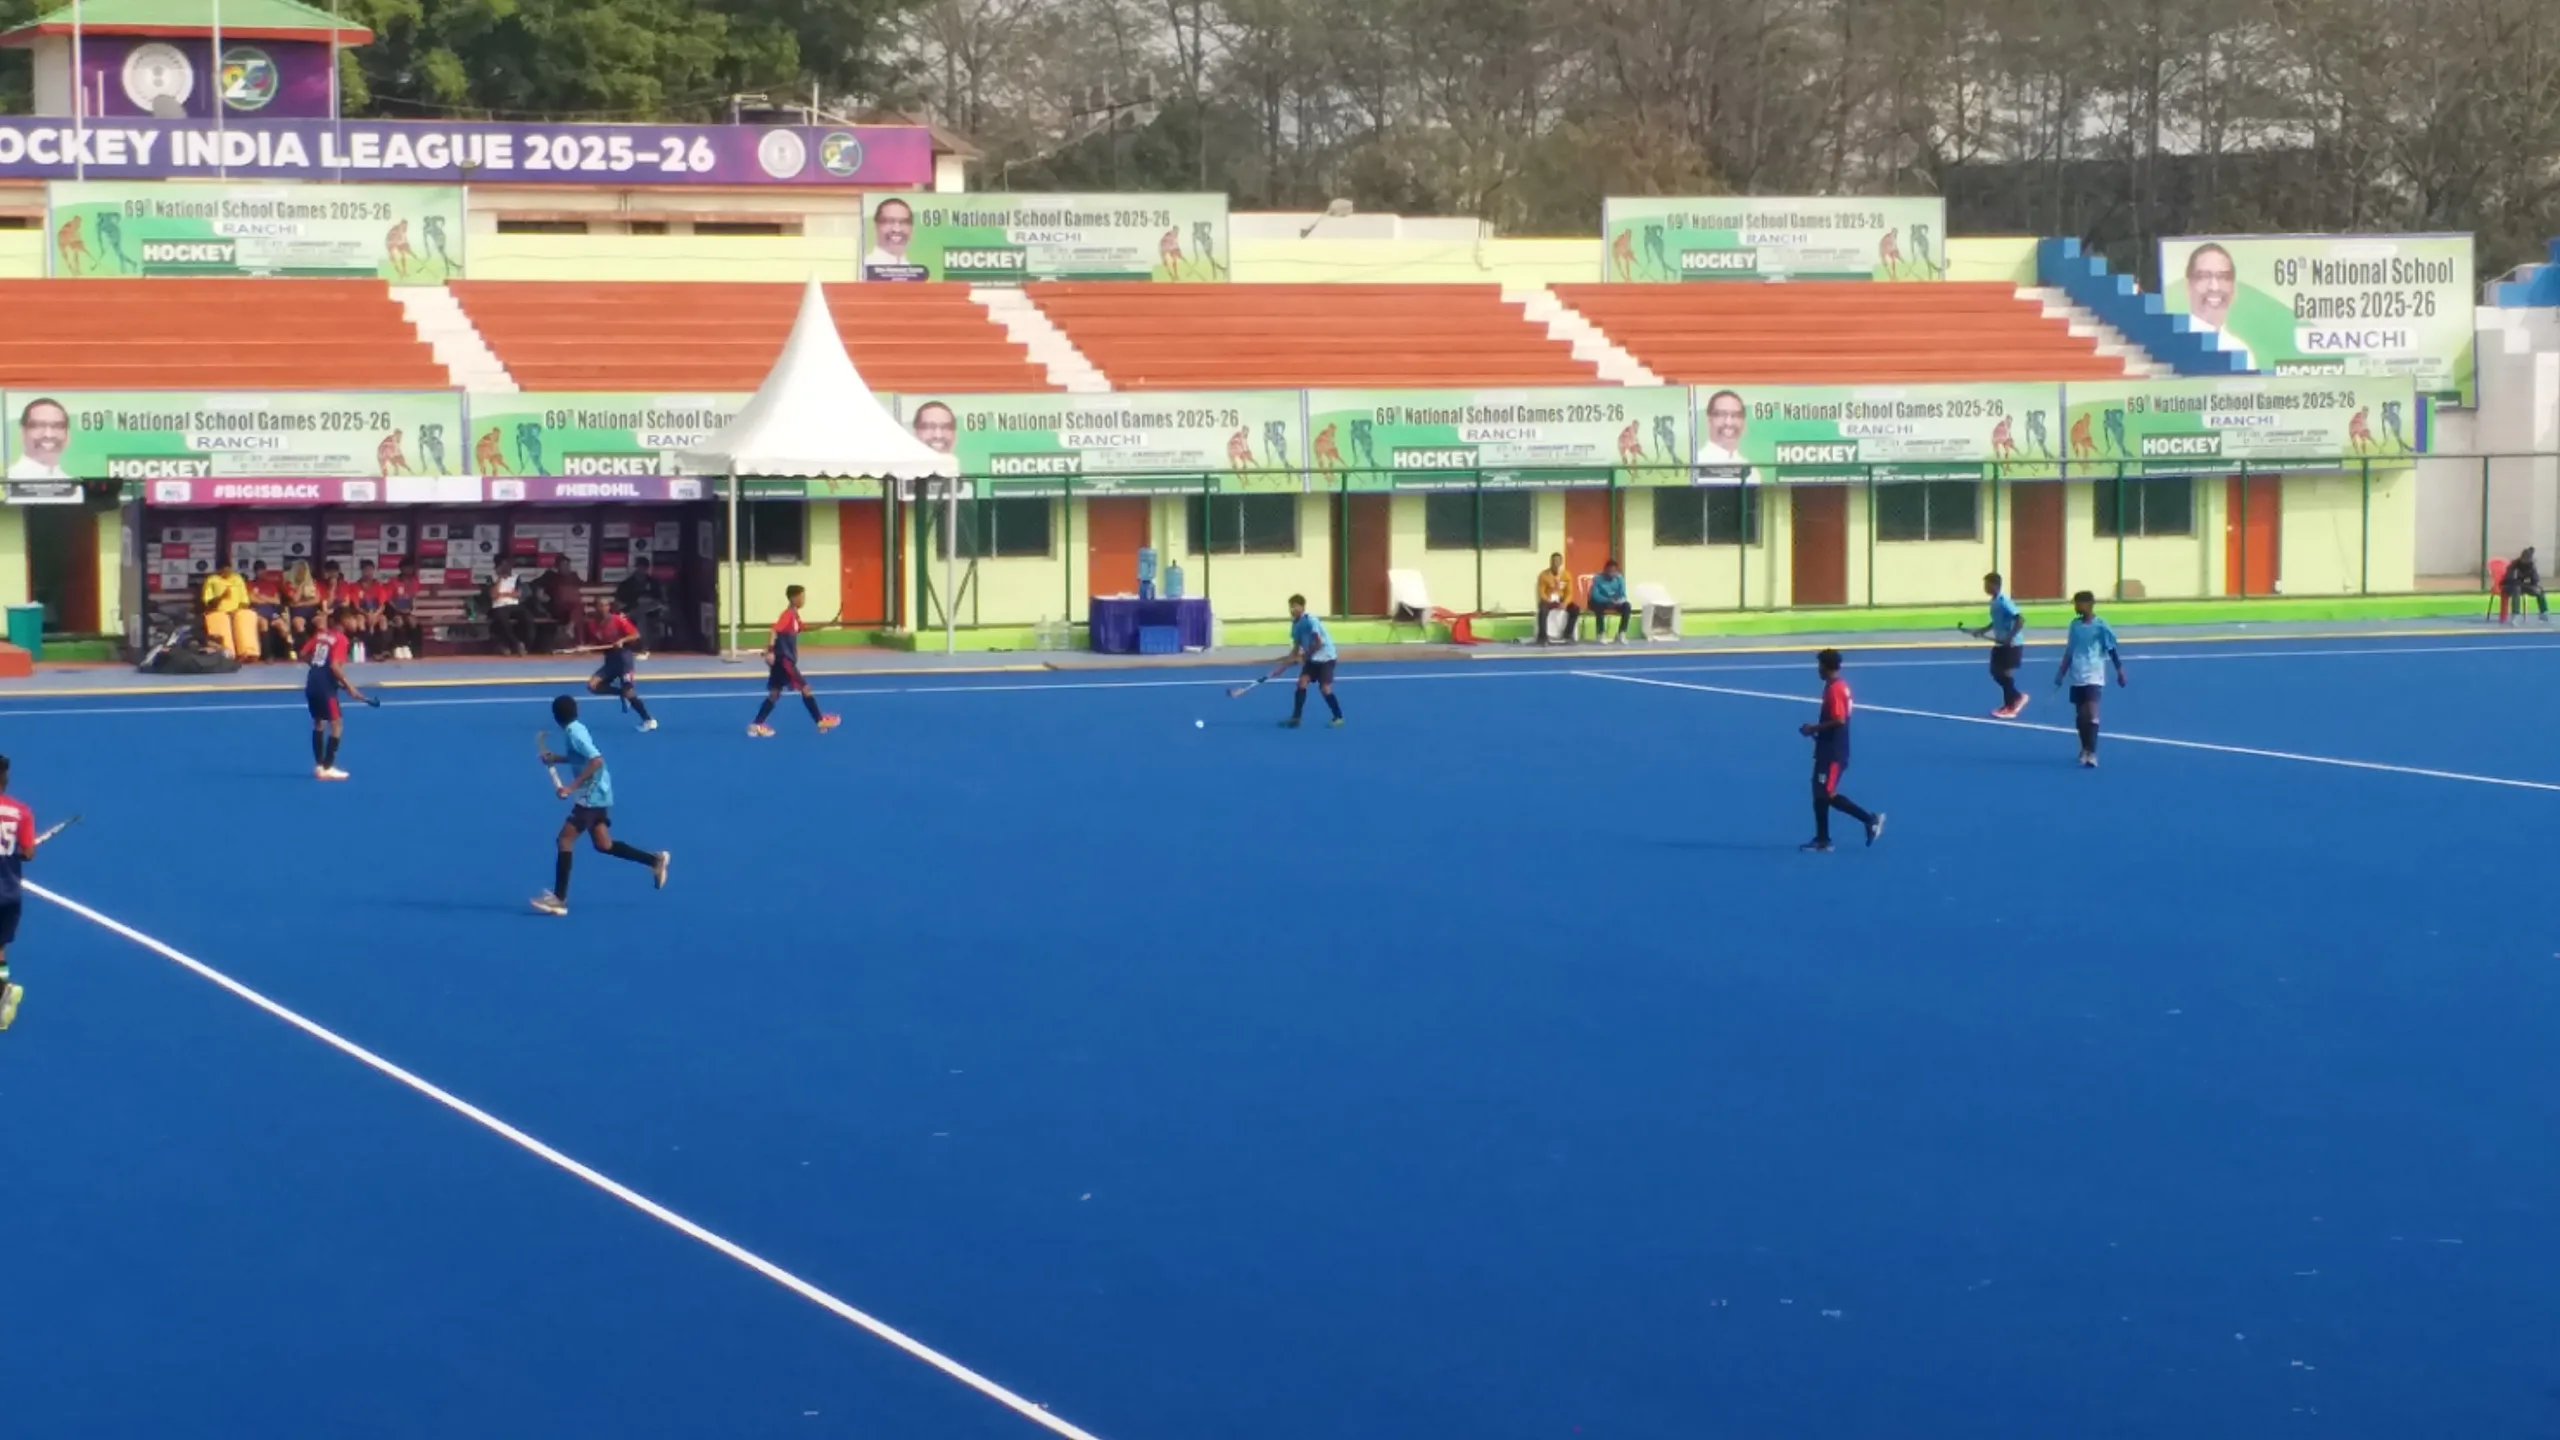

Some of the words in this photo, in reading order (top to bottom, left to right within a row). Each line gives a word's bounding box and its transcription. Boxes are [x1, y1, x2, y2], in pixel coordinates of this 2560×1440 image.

[0, 127, 159, 165] OCKEY
[172, 131, 309, 167] INDIA
[321, 133, 514, 168] LEAGUE
[524, 137, 715, 172] 2025-26
[156, 200, 218, 218] National
[222, 200, 274, 218] School
[277, 200, 326, 220] Games
[331, 202, 392, 220] 2025-26
[952, 208, 1010, 226] National
[1014, 208, 1062, 227] School
[1064, 209, 1111, 227] Games
[1114, 210, 1170, 227] 2025-26
[223, 224, 298, 236] RANCHI
[1015, 232, 1082, 243] RANCHI
[143, 244, 234, 262] HOCKEY
[944, 252, 1025, 268] HOCKEY
[1682, 252, 1756, 269] HOCKEY
[2312, 257, 2386, 285] National
[2392, 257, 2454, 284] School
[2294, 293, 2356, 320] Games
[2360, 290, 2436, 318] 2025-26
[2308, 330, 2406, 350] RANCHI
[1782, 402, 1842, 420] National
[1845, 401, 1894, 420] School
[1896, 400, 1944, 418] Games
[1946, 400, 2004, 418] 2025-26
[2153, 394, 2208, 412] National
[2210, 394, 2254, 412] School
[2256, 392, 2300, 410] Games
[2302, 391, 2356, 410] 2025-26
[117, 410, 190, 431] National
[194, 410, 254, 431] School
[258, 410, 316, 431] Games
[320, 410, 391, 431] 2025-26
[578, 410, 644, 430] National
[647, 410, 700, 430] School
[998, 410, 1062, 430] National
[1066, 410, 1119, 429] School
[1122, 410, 1174, 428] Games
[1177, 409, 1240, 428] 2025-26
[1404, 406, 1464, 425] National
[1466, 405, 1516, 424] School
[1518, 405, 1564, 424] Games
[1567, 404, 1624, 422] 2025-26
[2210, 415, 2274, 427] RANCHI
[1466, 428, 1537, 440] RANCHI
[1846, 424, 1914, 436] RANCHI
[196, 436, 280, 449] RANCHI
[1068, 434, 1142, 446] RANCHI
[2142, 437, 2220, 456] HOCKEY
[1394, 450, 1478, 468] HOCKEY
[1776, 446, 1858, 463] HOCKEY
[108, 460, 210, 478] HOCKEY
[564, 456, 658, 476] HOCKEY
[990, 456, 1081, 474] HOCKEY
[213, 484, 320, 498] #BIGISBACK
[555, 482, 641, 496] #HEROHIL
